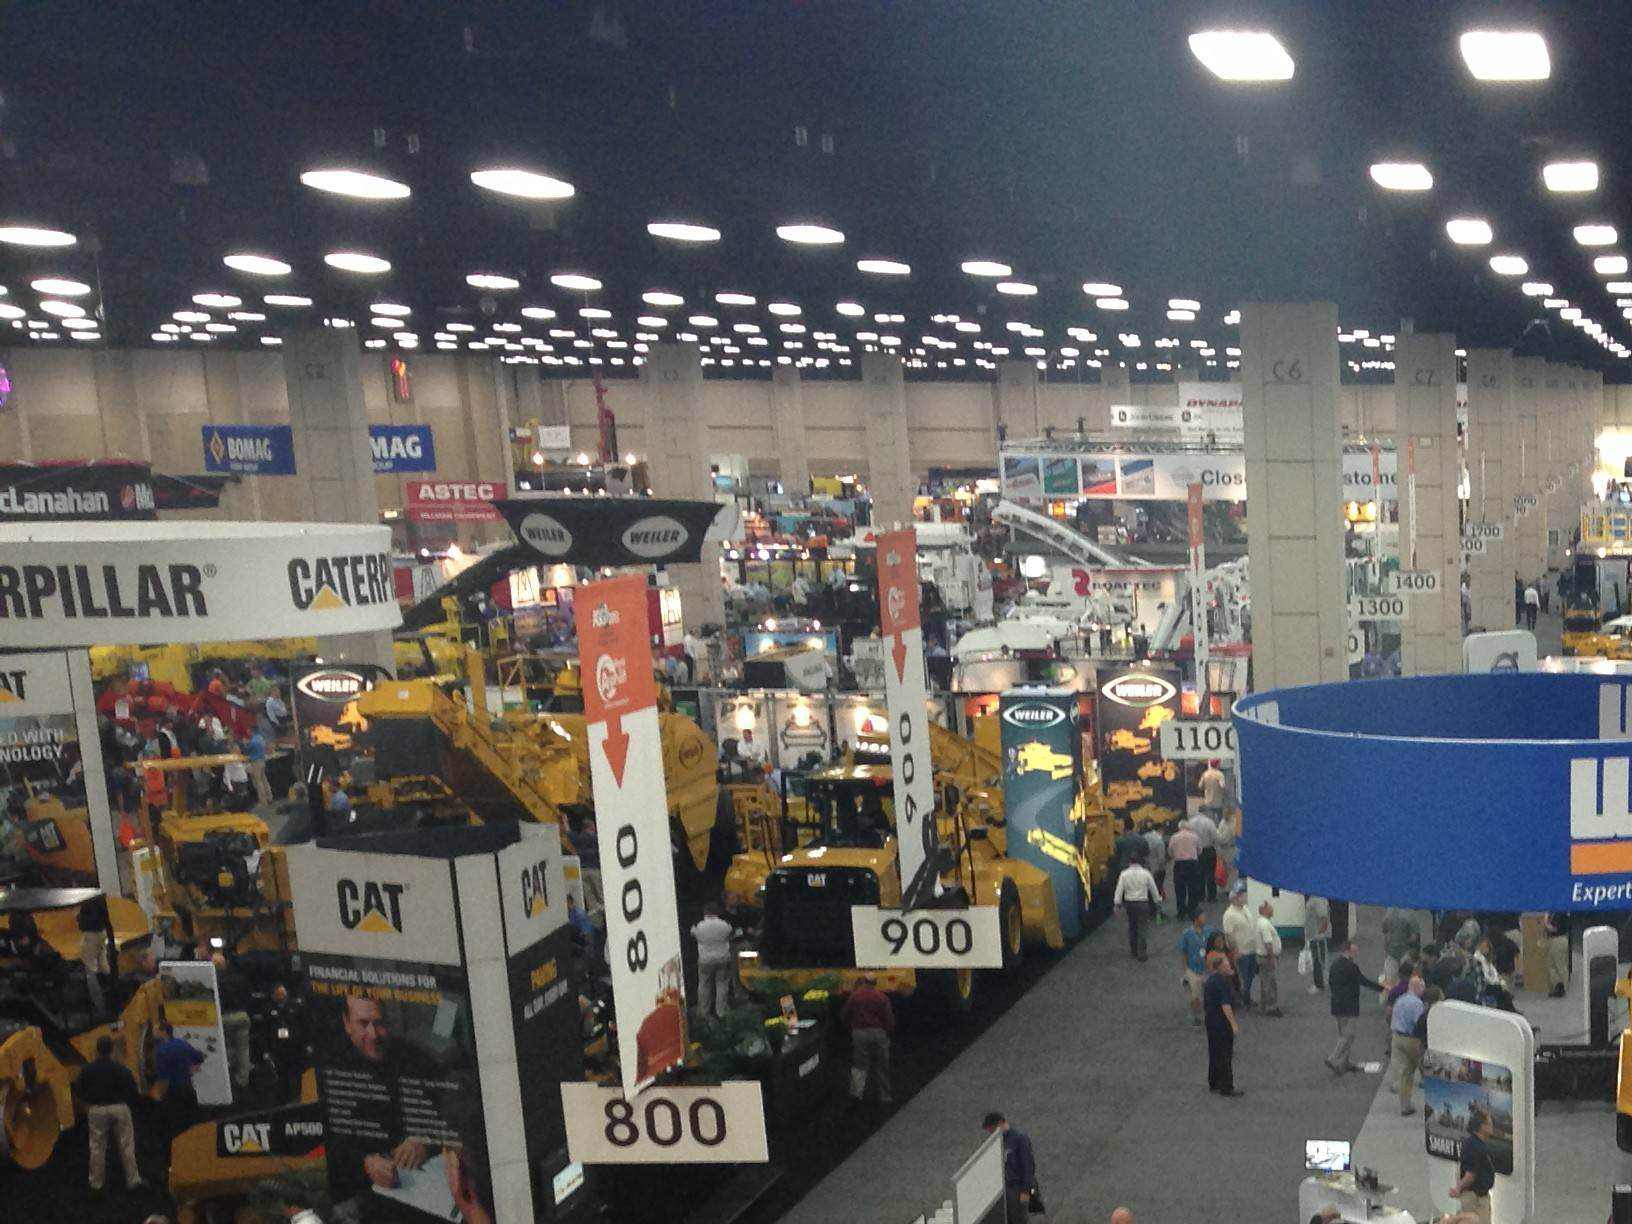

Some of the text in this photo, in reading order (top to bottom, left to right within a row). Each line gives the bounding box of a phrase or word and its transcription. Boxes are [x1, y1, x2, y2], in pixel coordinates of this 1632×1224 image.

[227, 437, 272, 461] BOMAG
[418, 483, 494, 500] ASTEC
[525, 526, 565, 542] WEILER
[629, 529, 681, 545] WEILER
[1395, 575, 1436, 590] 1400
[1357, 599, 1404, 616] 1300
[309, 676, 360, 694] WEILER
[1014, 709, 1054, 721] WEILER
[521, 860, 549, 919] CAT
[615, 824, 649, 975] 800
[337, 878, 405, 934] CAT
[880, 918, 974, 956] 900
[309, 964, 359, 984] FINANCIAL
[605, 1098, 727, 1148] 800
[224, 1123, 271, 1153] CAT
